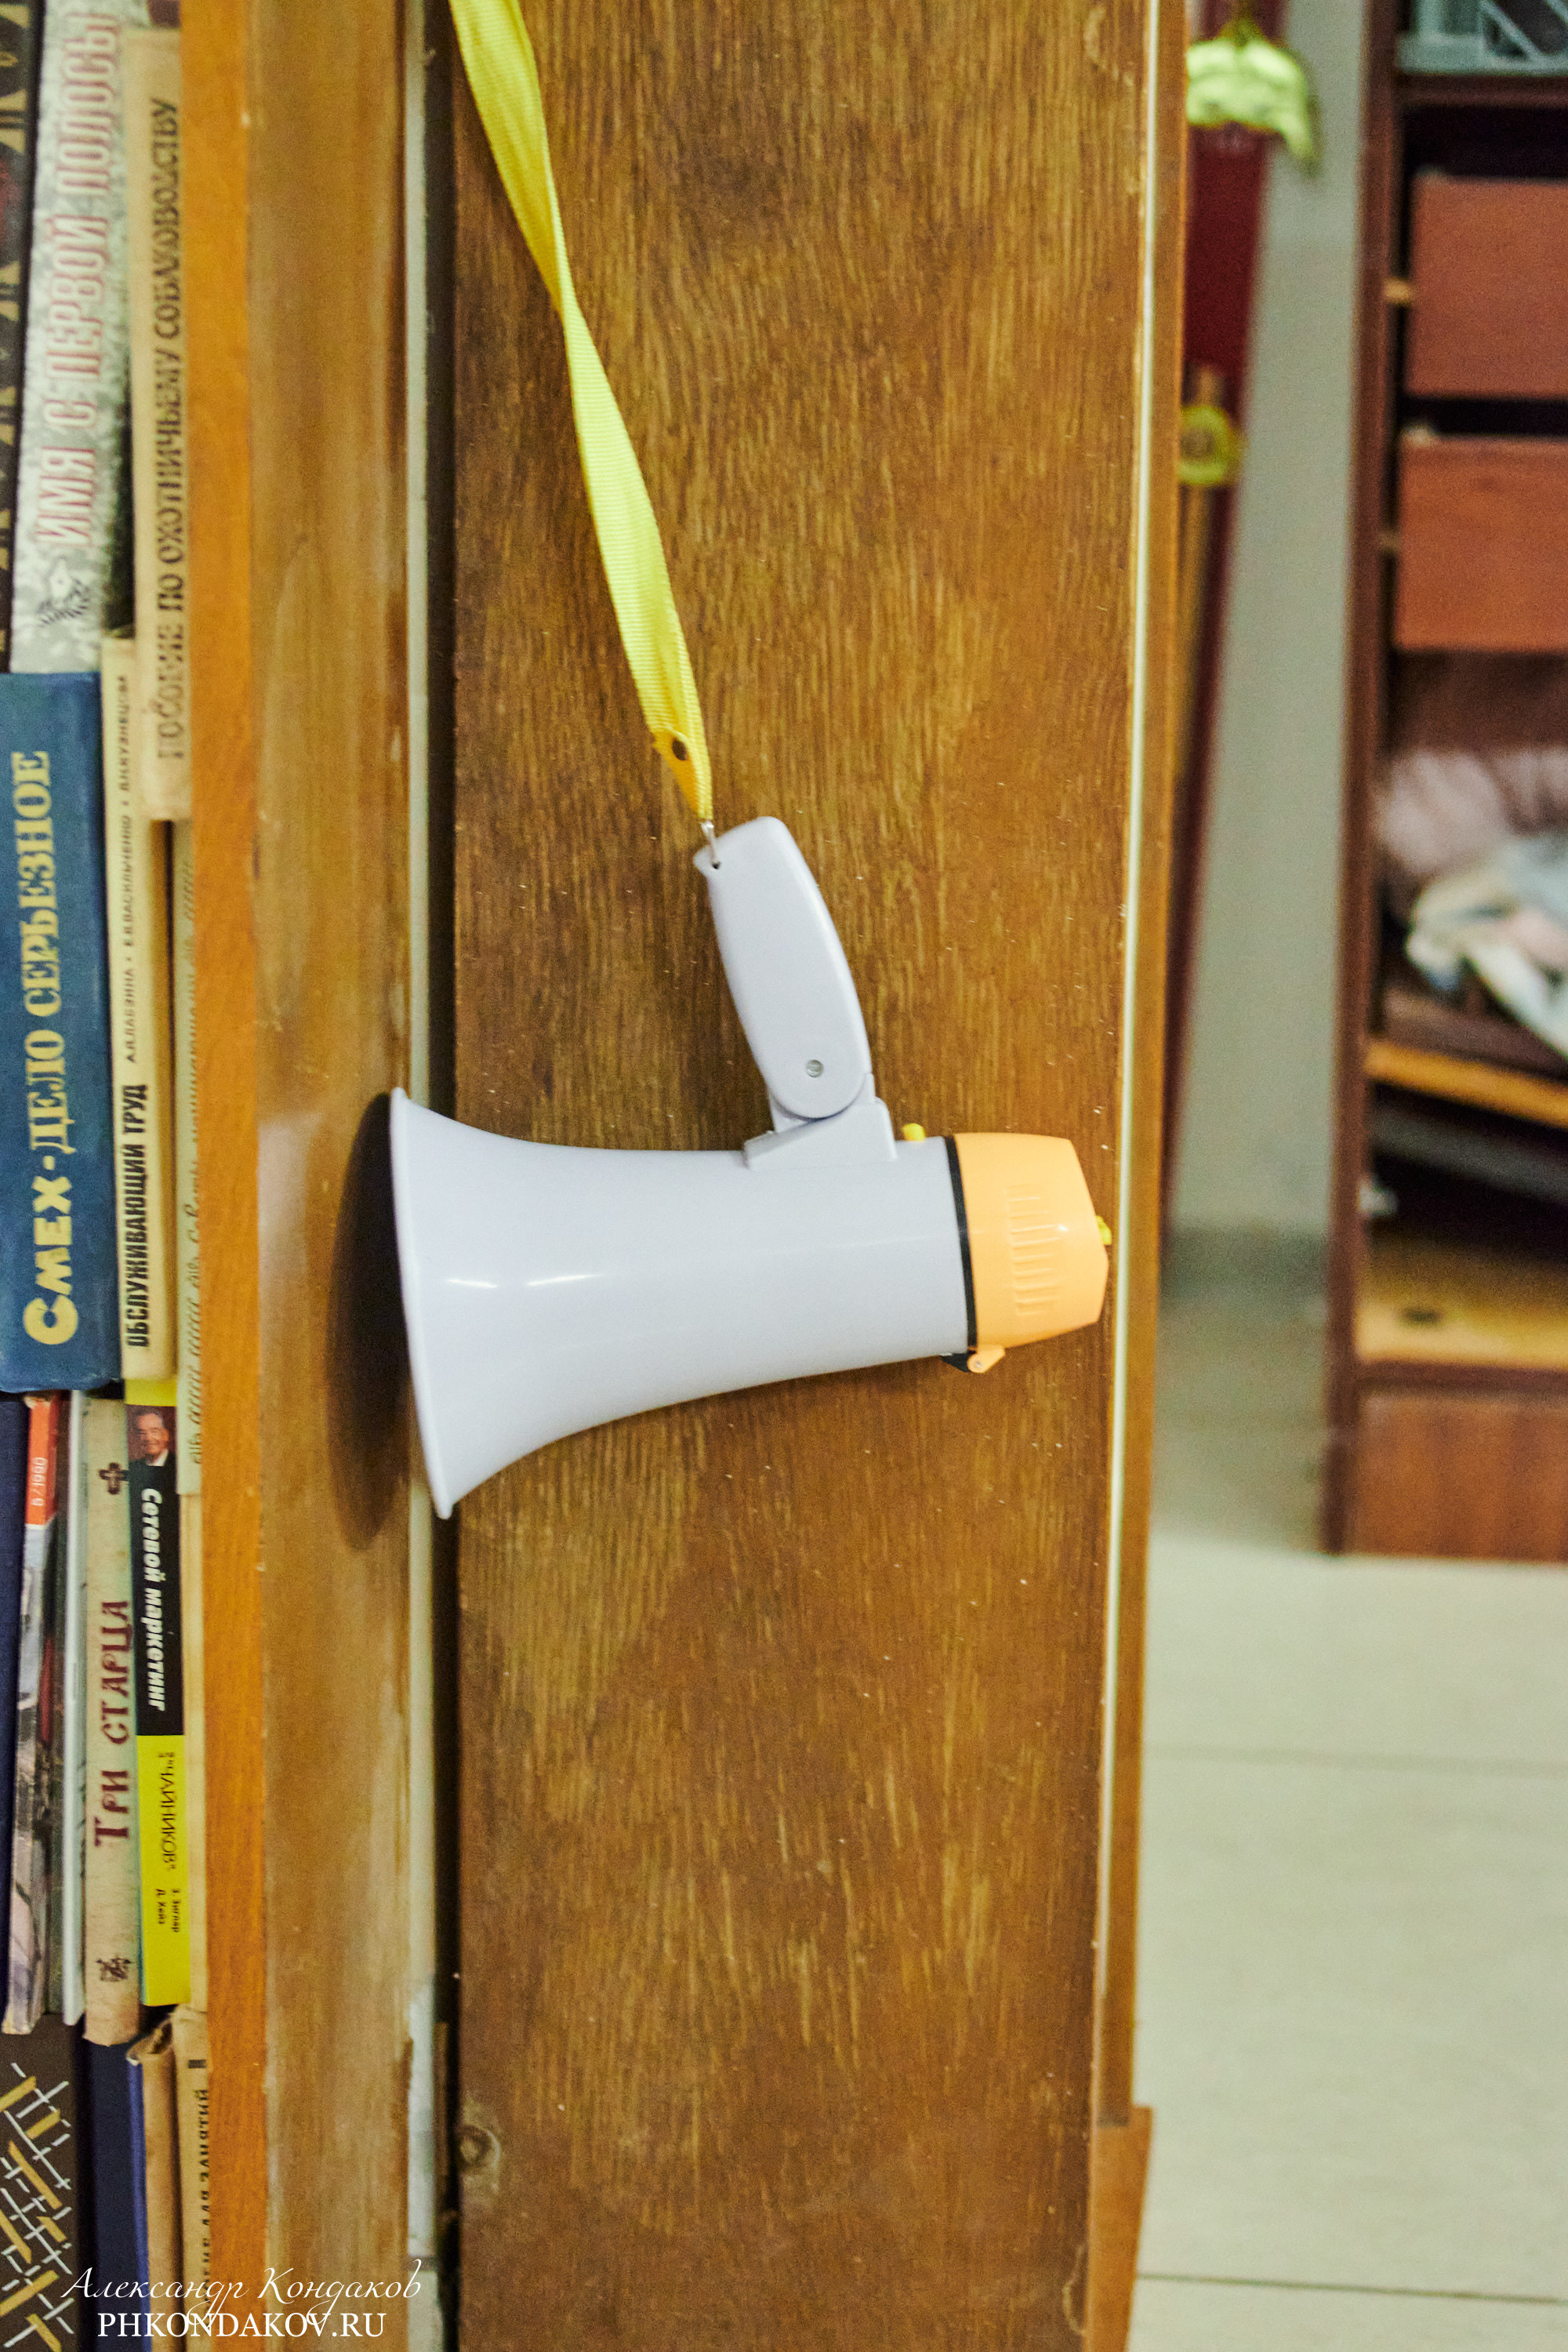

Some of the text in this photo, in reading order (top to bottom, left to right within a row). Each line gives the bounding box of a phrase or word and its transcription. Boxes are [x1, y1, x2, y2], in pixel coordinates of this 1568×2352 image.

[34, 13, 120, 546] ИМЯ С ПЕРВОЙ ПОЛОСЫ
[150, 96, 183, 759] ПОСОБИЕ ПО ОХОТНИЧЬЕМУ СОБАКОВОДСТВУ
[11, 751, 61, 1017] СЕРЬЕЗНОЕ
[120, 1084, 149, 1347] ОБСЛУЖИВАЮЩИЙ ТРУД
[140, 1488, 166, 1711] Сетевой маркетинг
